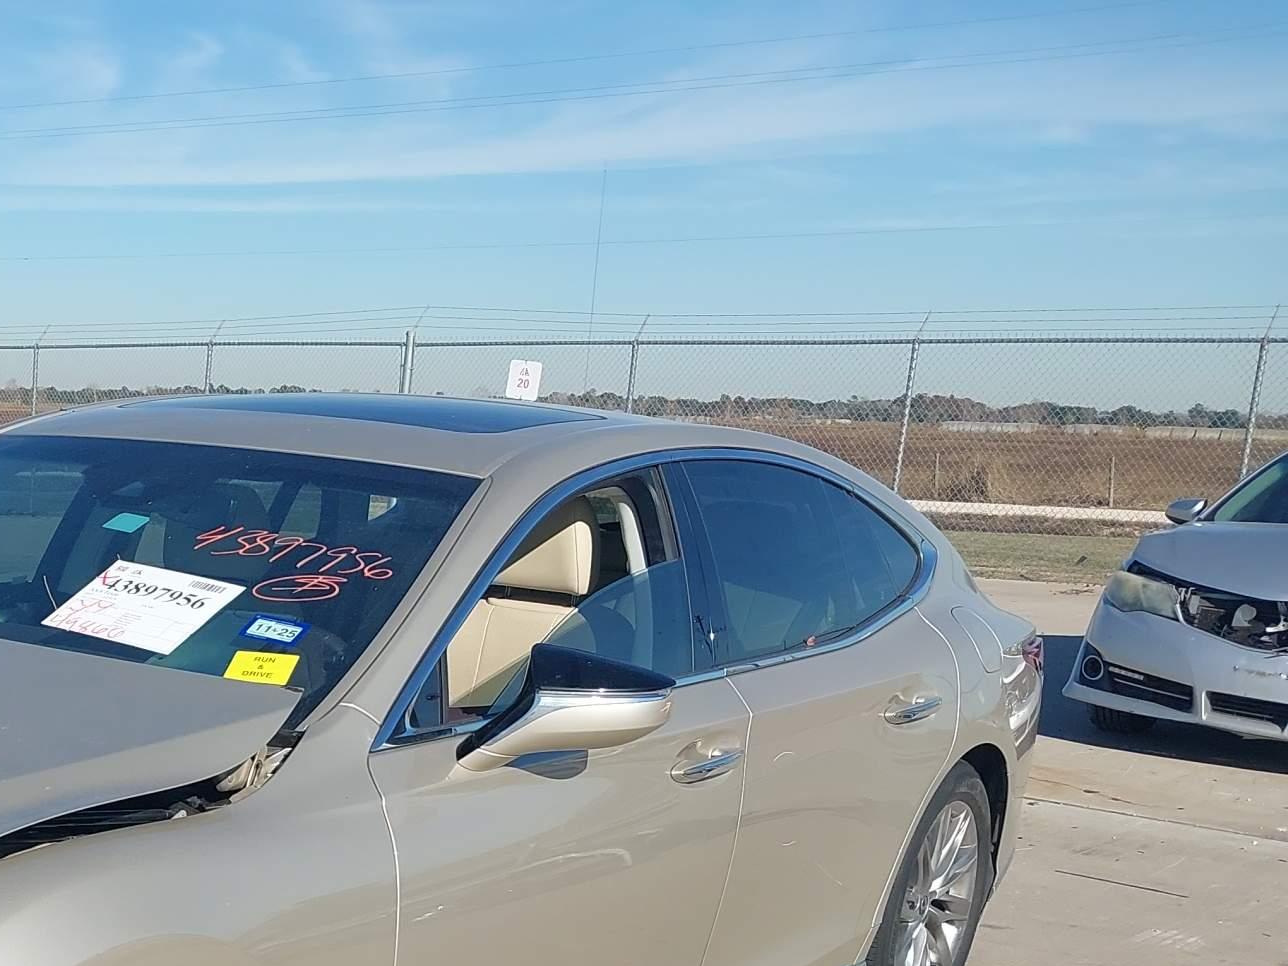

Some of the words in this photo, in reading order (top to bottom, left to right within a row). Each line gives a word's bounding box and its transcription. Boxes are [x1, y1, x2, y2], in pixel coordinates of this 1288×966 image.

[516, 378, 530, 389] 20
[193, 526, 393, 580] 43897956
[102, 577, 211, 610] 43897956
[253, 655, 277, 664] RUN
[240, 670, 274, 679] DRIVE
